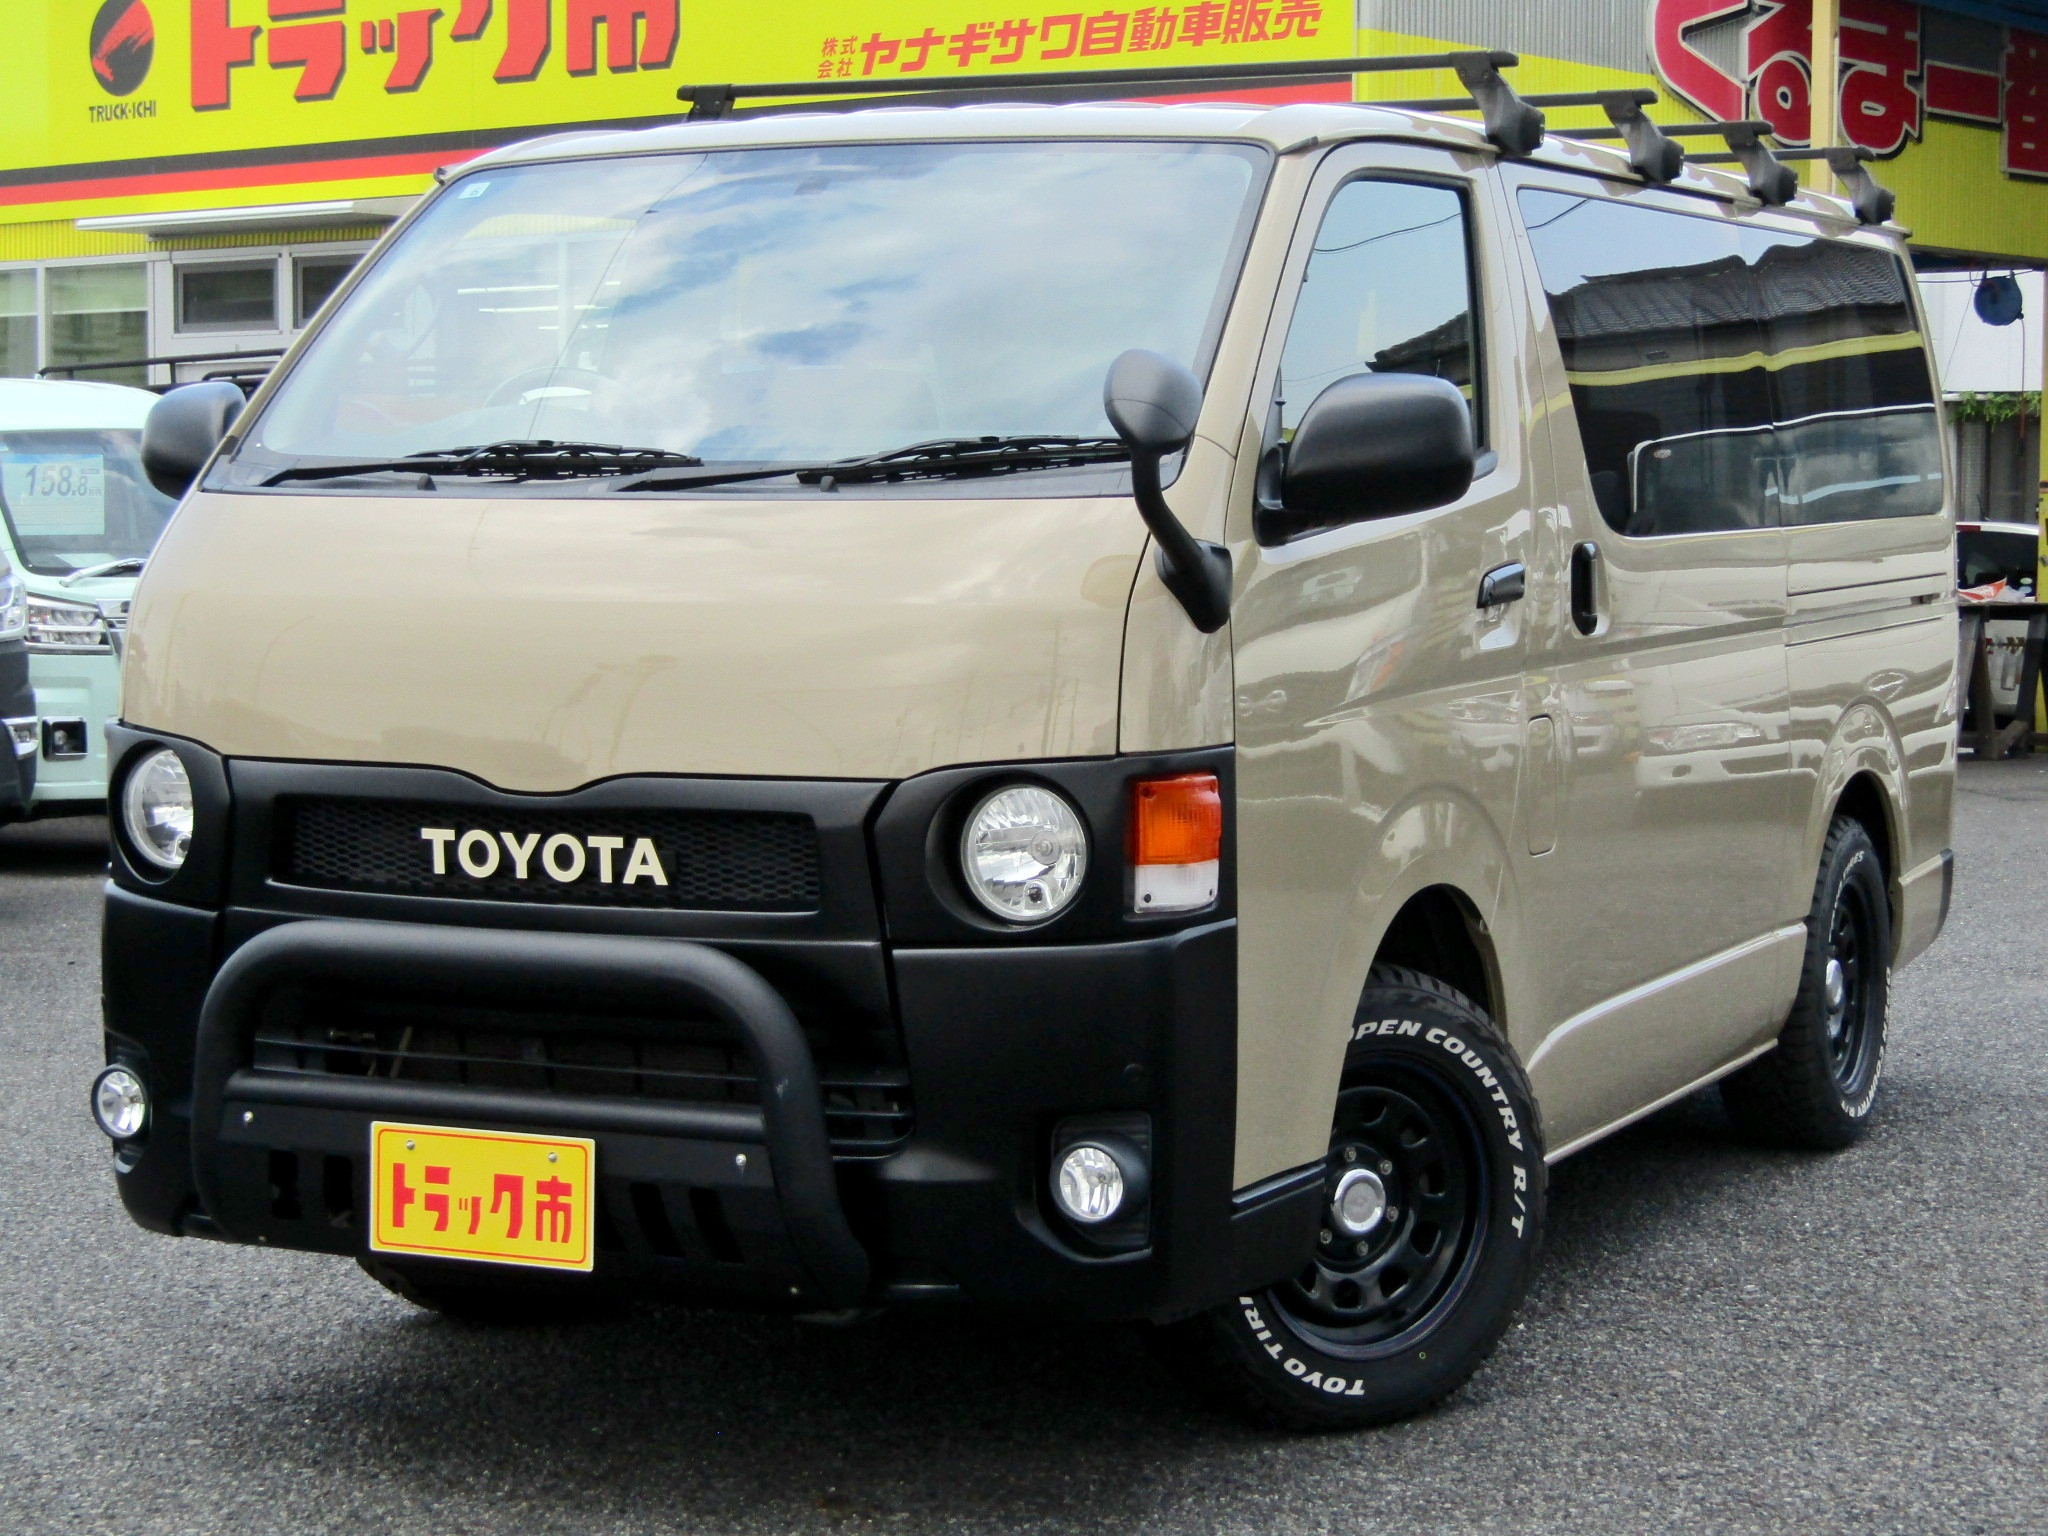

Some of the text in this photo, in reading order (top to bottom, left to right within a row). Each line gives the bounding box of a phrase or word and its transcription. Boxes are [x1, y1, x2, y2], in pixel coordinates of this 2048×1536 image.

[860, 0, 1322, 76] ヤナギサワ自動車販売
[421, 827, 669, 886] TOYOTA
[1425, 1027, 1524, 1151] COUNTRY
[1511, 1165, 1527, 1239] R/T
[392, 1162, 573, 1243] トラック市
[1284, 1357, 1365, 1396] TOYO
